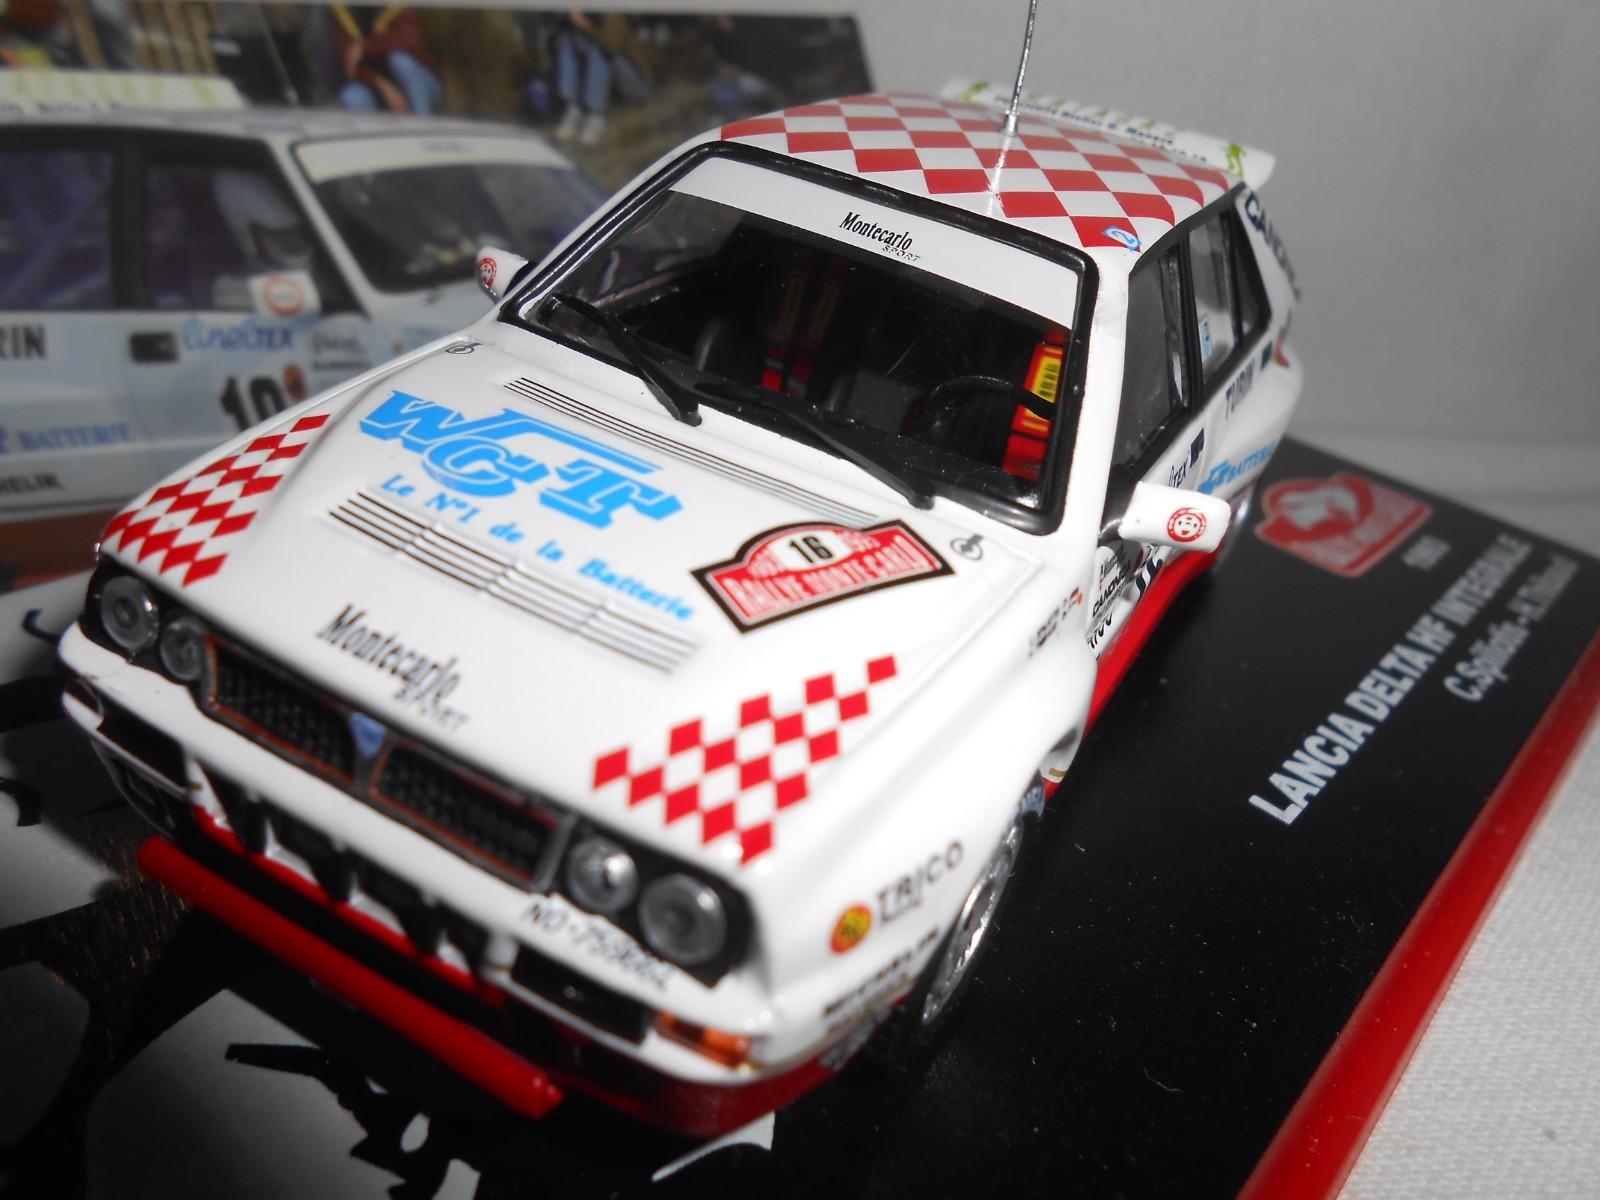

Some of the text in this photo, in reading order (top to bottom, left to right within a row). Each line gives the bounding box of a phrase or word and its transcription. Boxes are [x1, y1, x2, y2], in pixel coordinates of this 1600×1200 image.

[838, 211, 914, 251] Montecarlo
[881, 244, 922, 262] SPORT
[381, 474, 416, 497] Le
[489, 522, 524, 543] de
[536, 539, 564, 562] la
[578, 558, 694, 622] Batterie
[789, 535, 834, 565] 16
[315, 602, 462, 703] Montecarlo
[1248, 712, 1376, 825] LANCIA
[1344, 644, 1436, 723] DELTA
[1404, 613, 1456, 655] HF
[1430, 533, 1533, 627] INTEGRALE
[394, 687, 472, 732] SPORT
